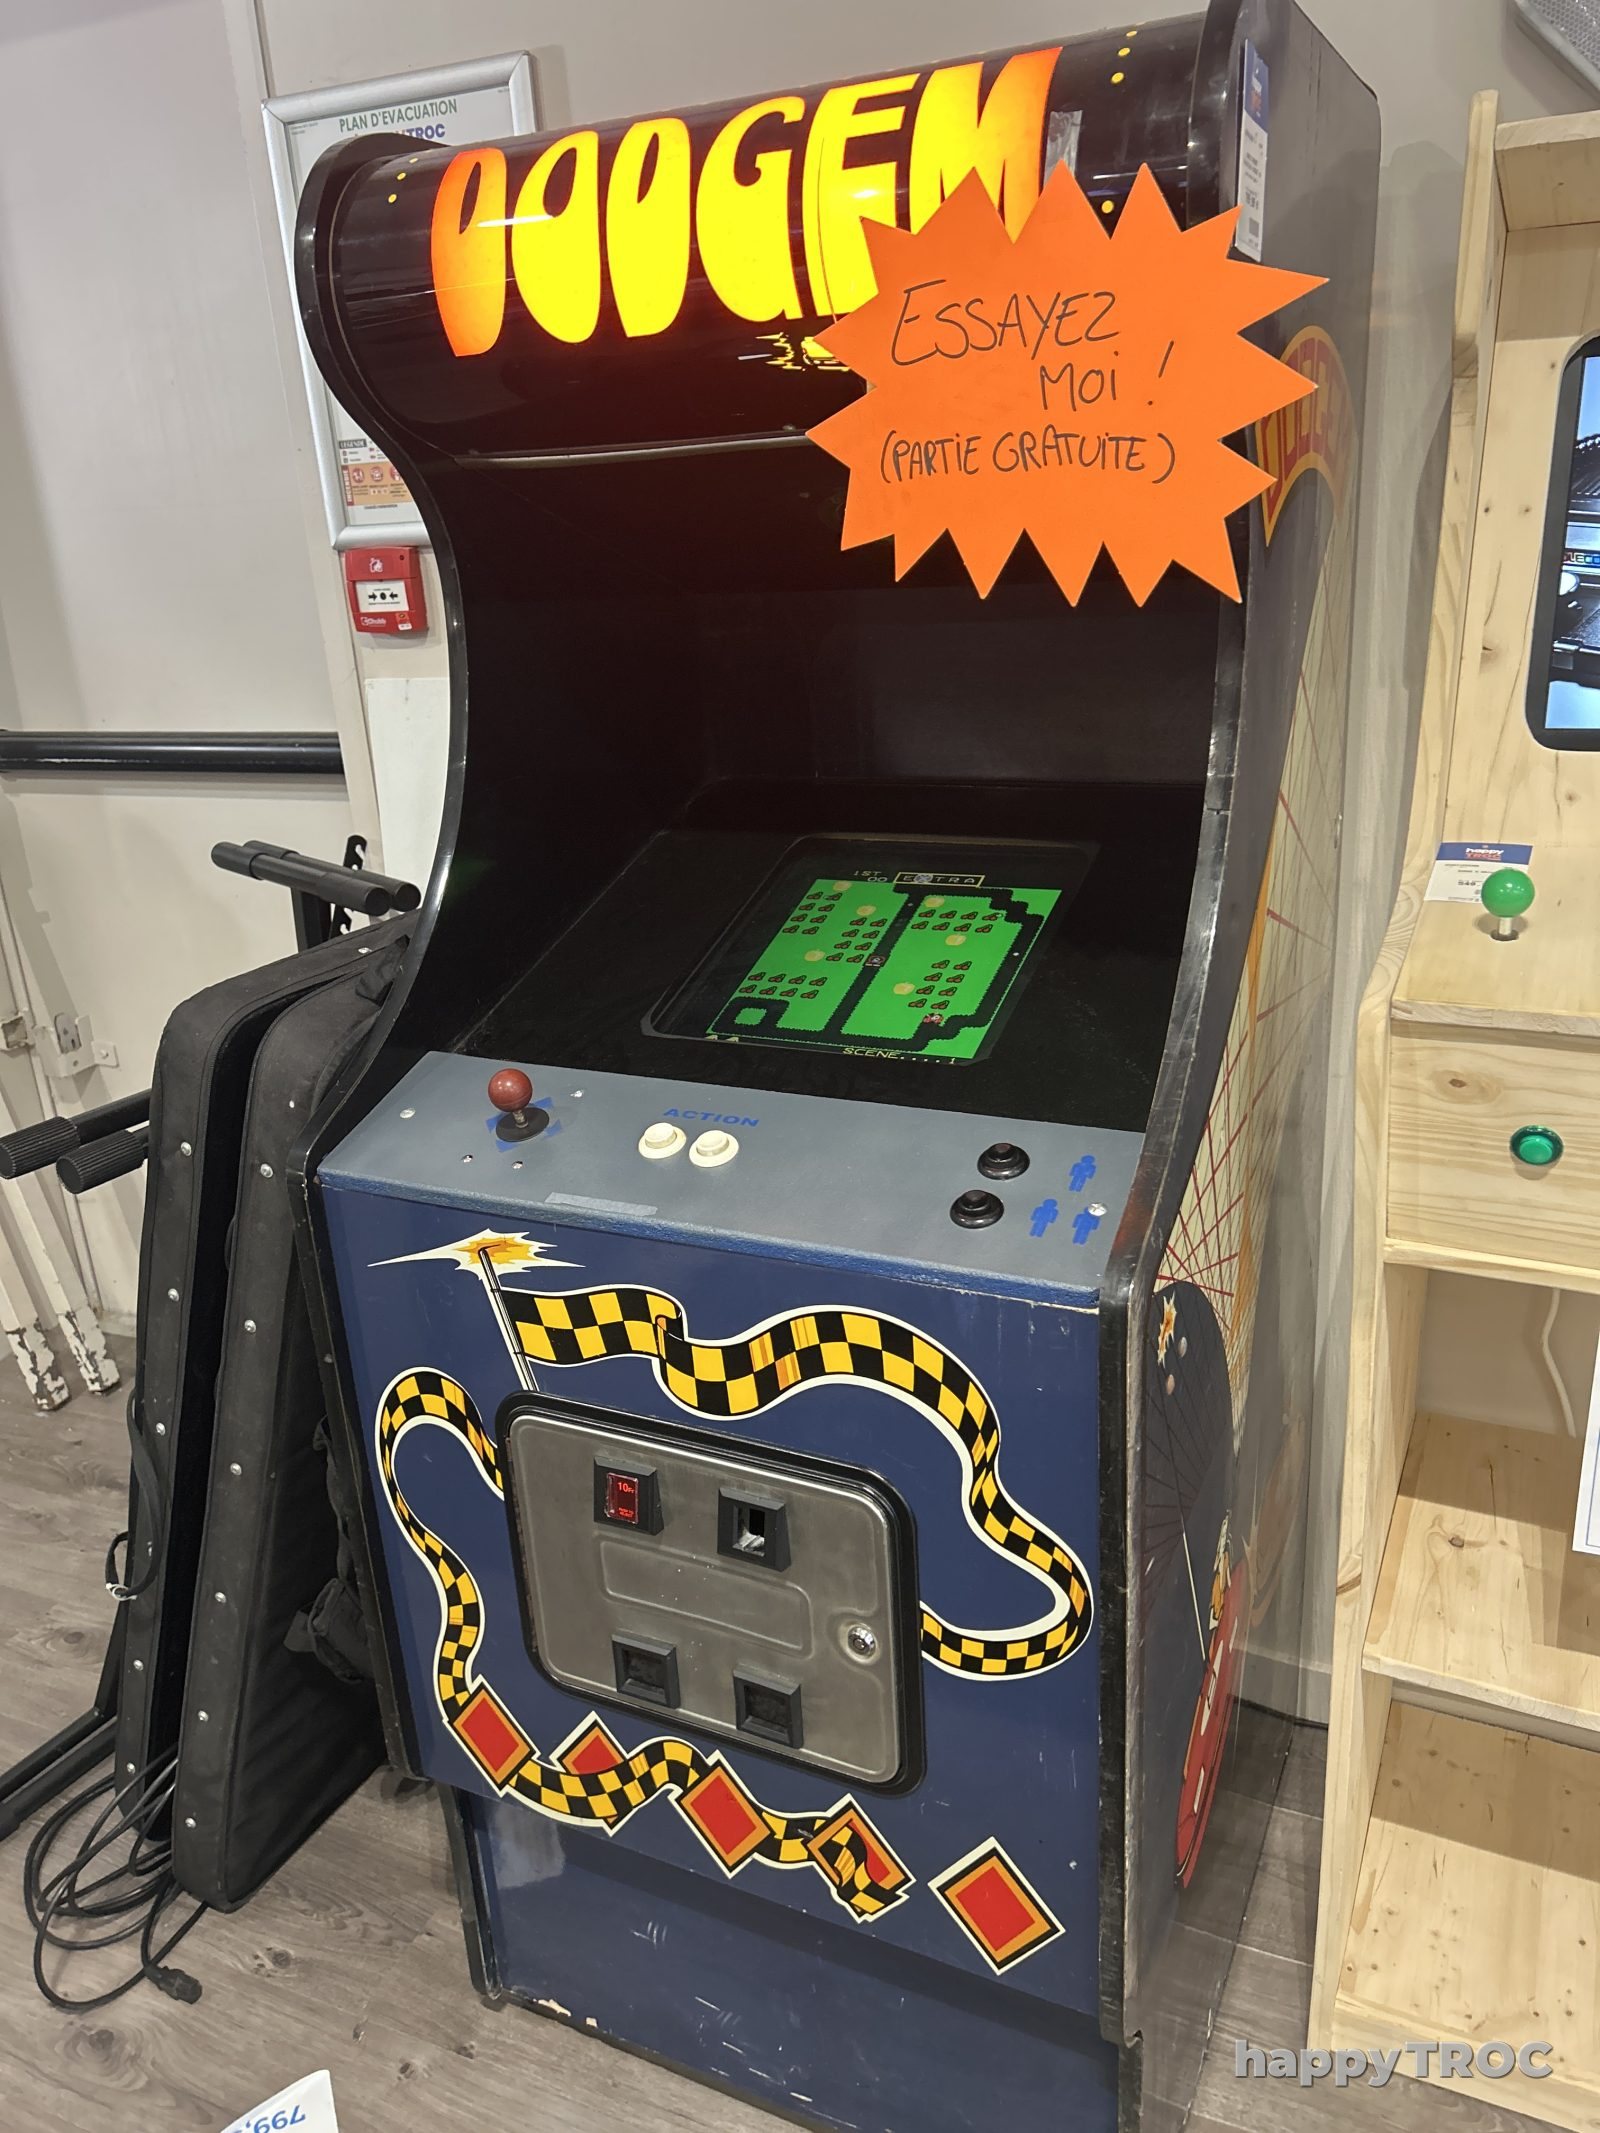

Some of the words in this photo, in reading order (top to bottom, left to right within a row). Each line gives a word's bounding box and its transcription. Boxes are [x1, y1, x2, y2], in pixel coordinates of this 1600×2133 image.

[339, 112, 368, 133] PLAN
[371, 98, 458, 128] D'EVACUATION
[430, 46, 1063, 358] DODGEM
[891, 279, 1120, 366] ESSAYEZ
[903, 873, 975, 884] EXTRA
[663, 1108, 760, 1127] ACTION
[232, 2104, 307, 2133] 799,
